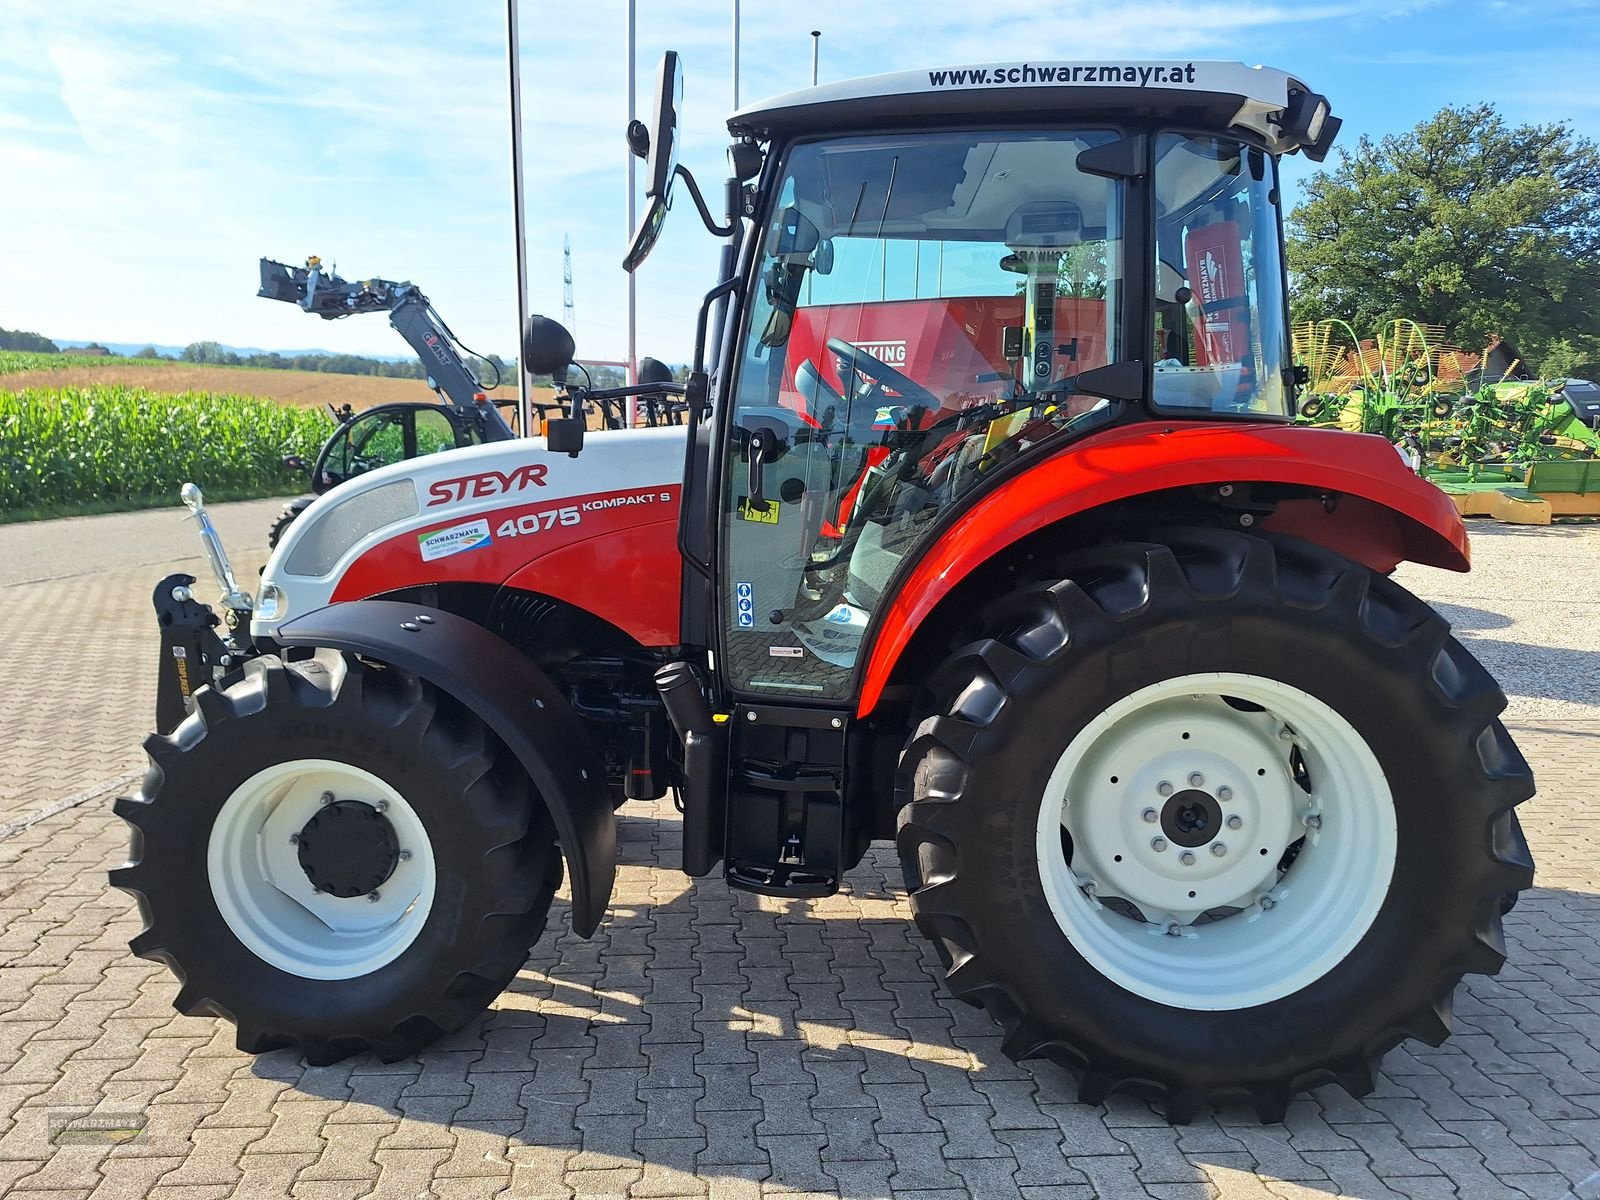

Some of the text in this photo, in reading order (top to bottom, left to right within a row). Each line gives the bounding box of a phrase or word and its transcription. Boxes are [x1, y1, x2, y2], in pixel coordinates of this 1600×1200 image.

[928, 62, 1196, 87] www.schwarzmayr.at
[426, 463, 548, 507] STEYR
[496, 492, 671, 538] 4075 KOMPAKT S
[425, 528, 479, 546] SCHWARZMAYR
